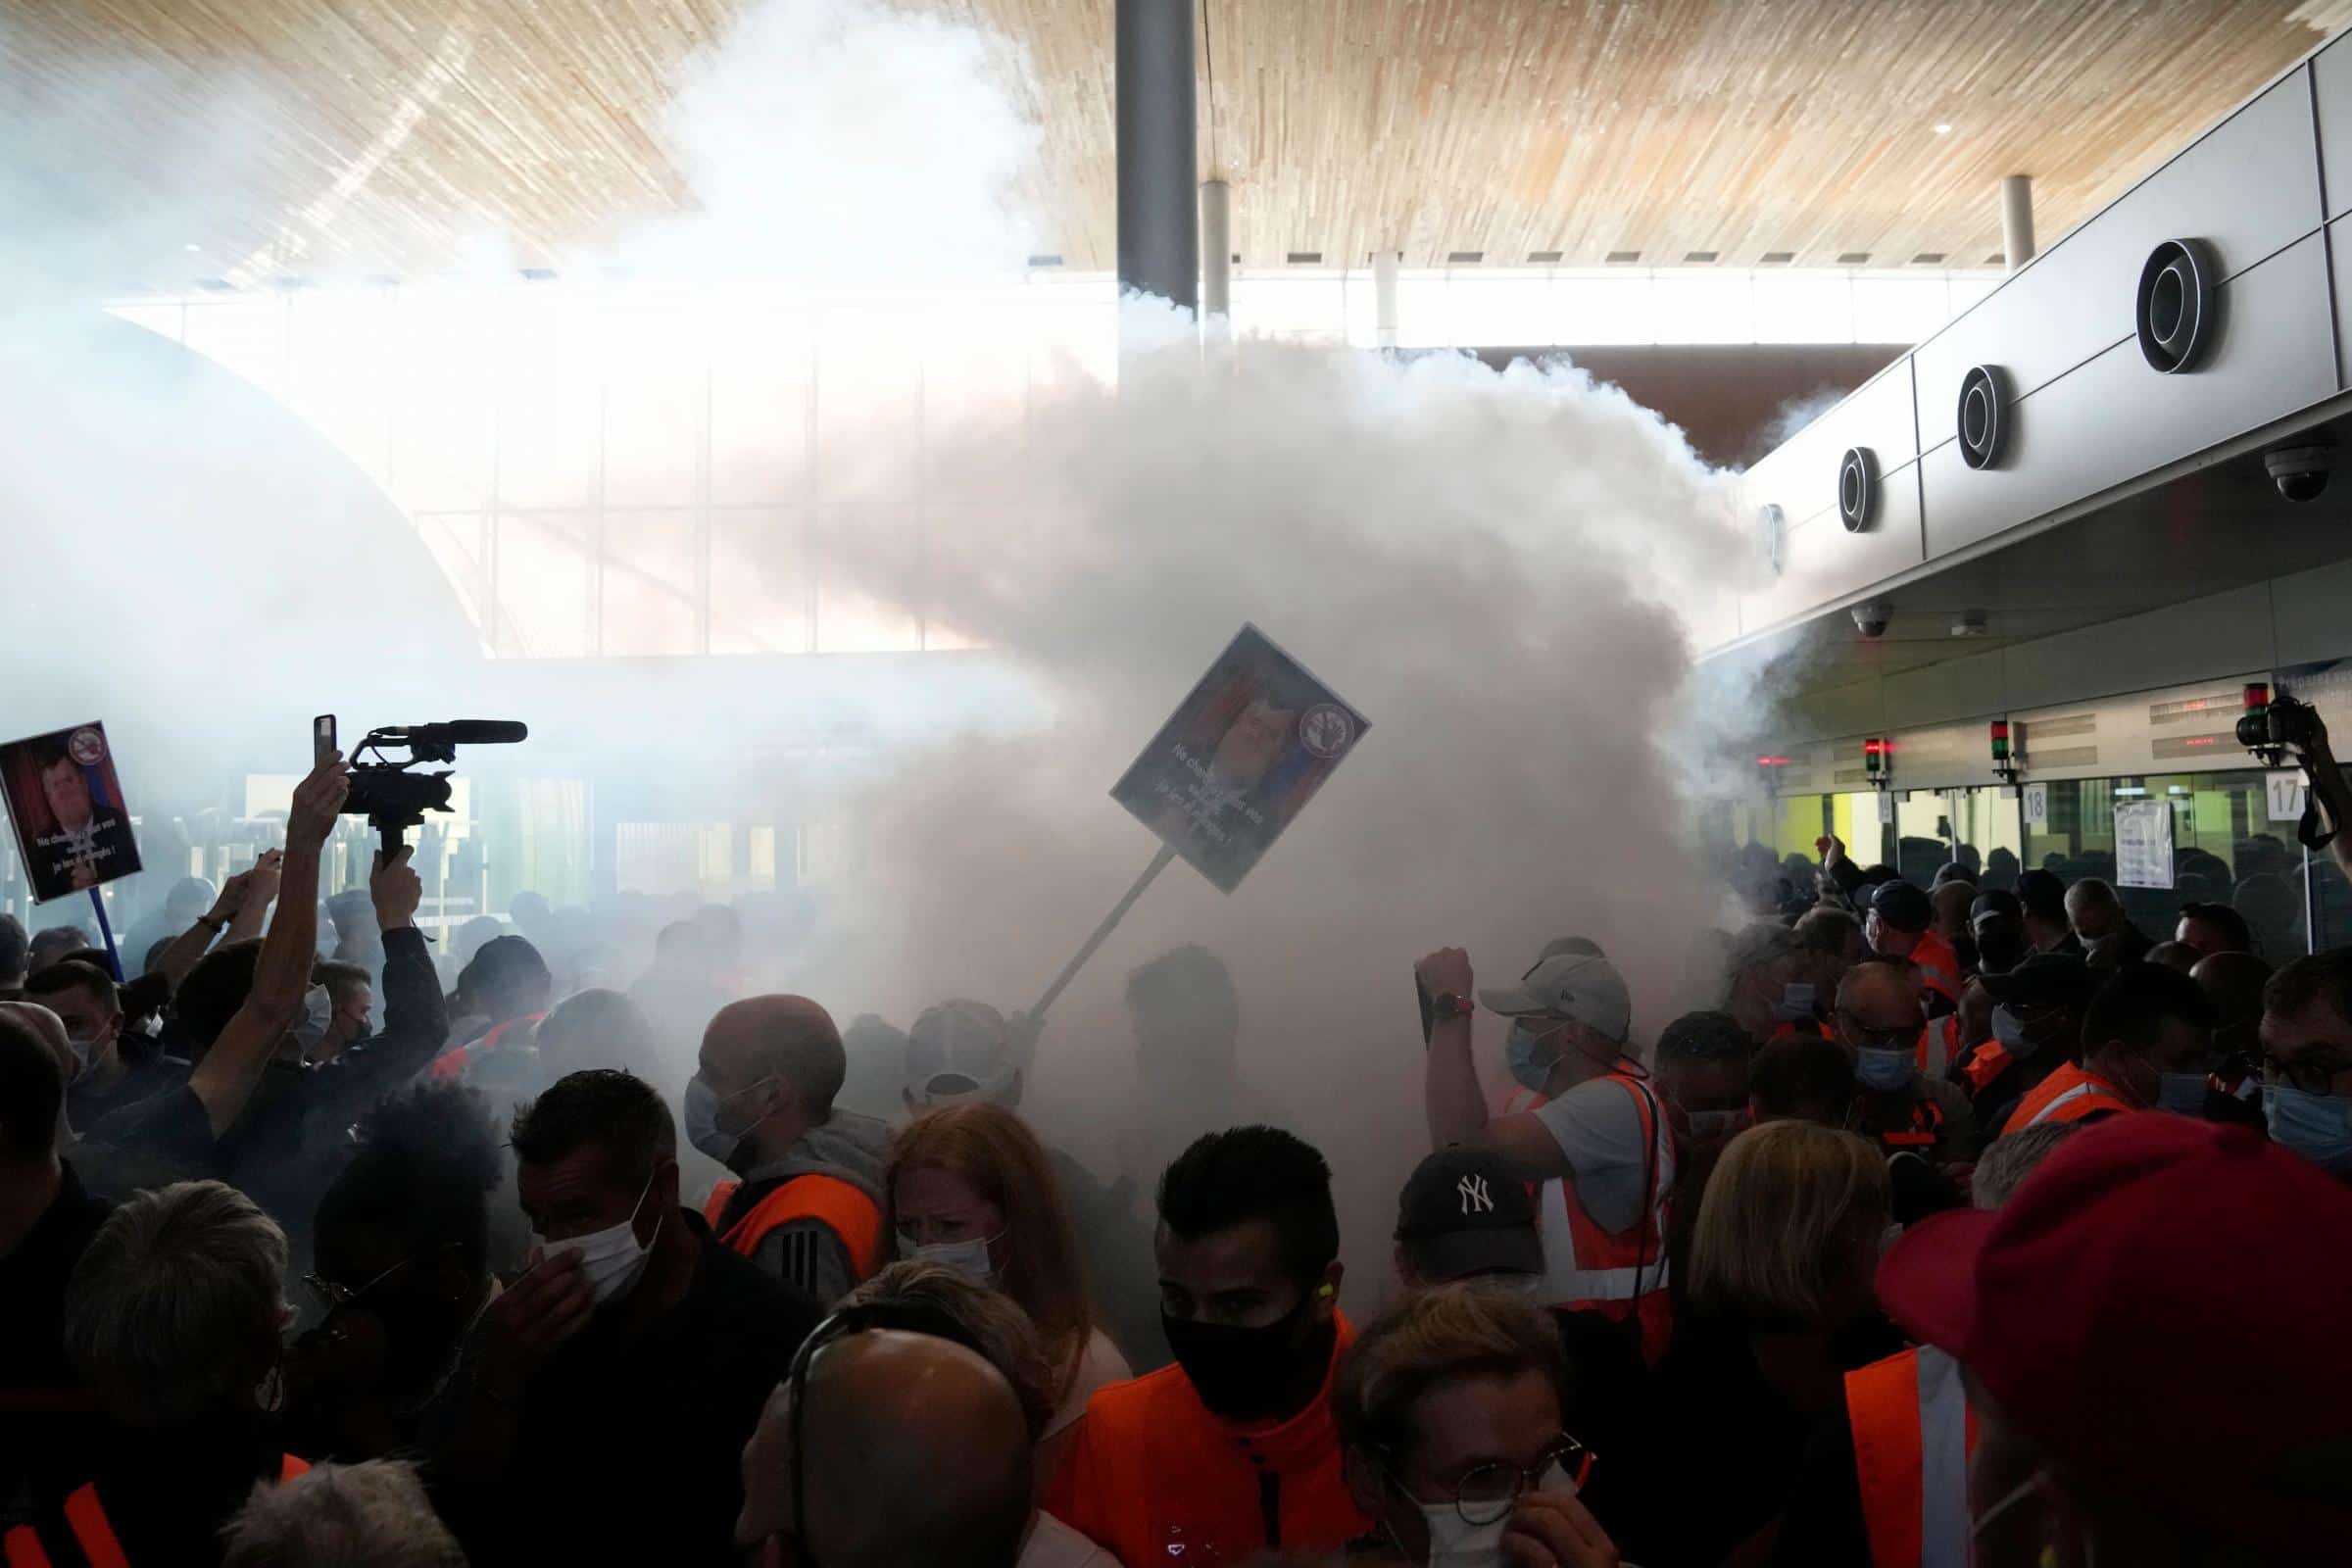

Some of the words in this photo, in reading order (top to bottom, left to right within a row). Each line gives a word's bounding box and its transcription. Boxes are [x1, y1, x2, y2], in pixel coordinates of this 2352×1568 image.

[2028, 791, 2043, 816] 18
[2274, 779, 2298, 812] 17
[1456, 1173, 1494, 1215] NY
